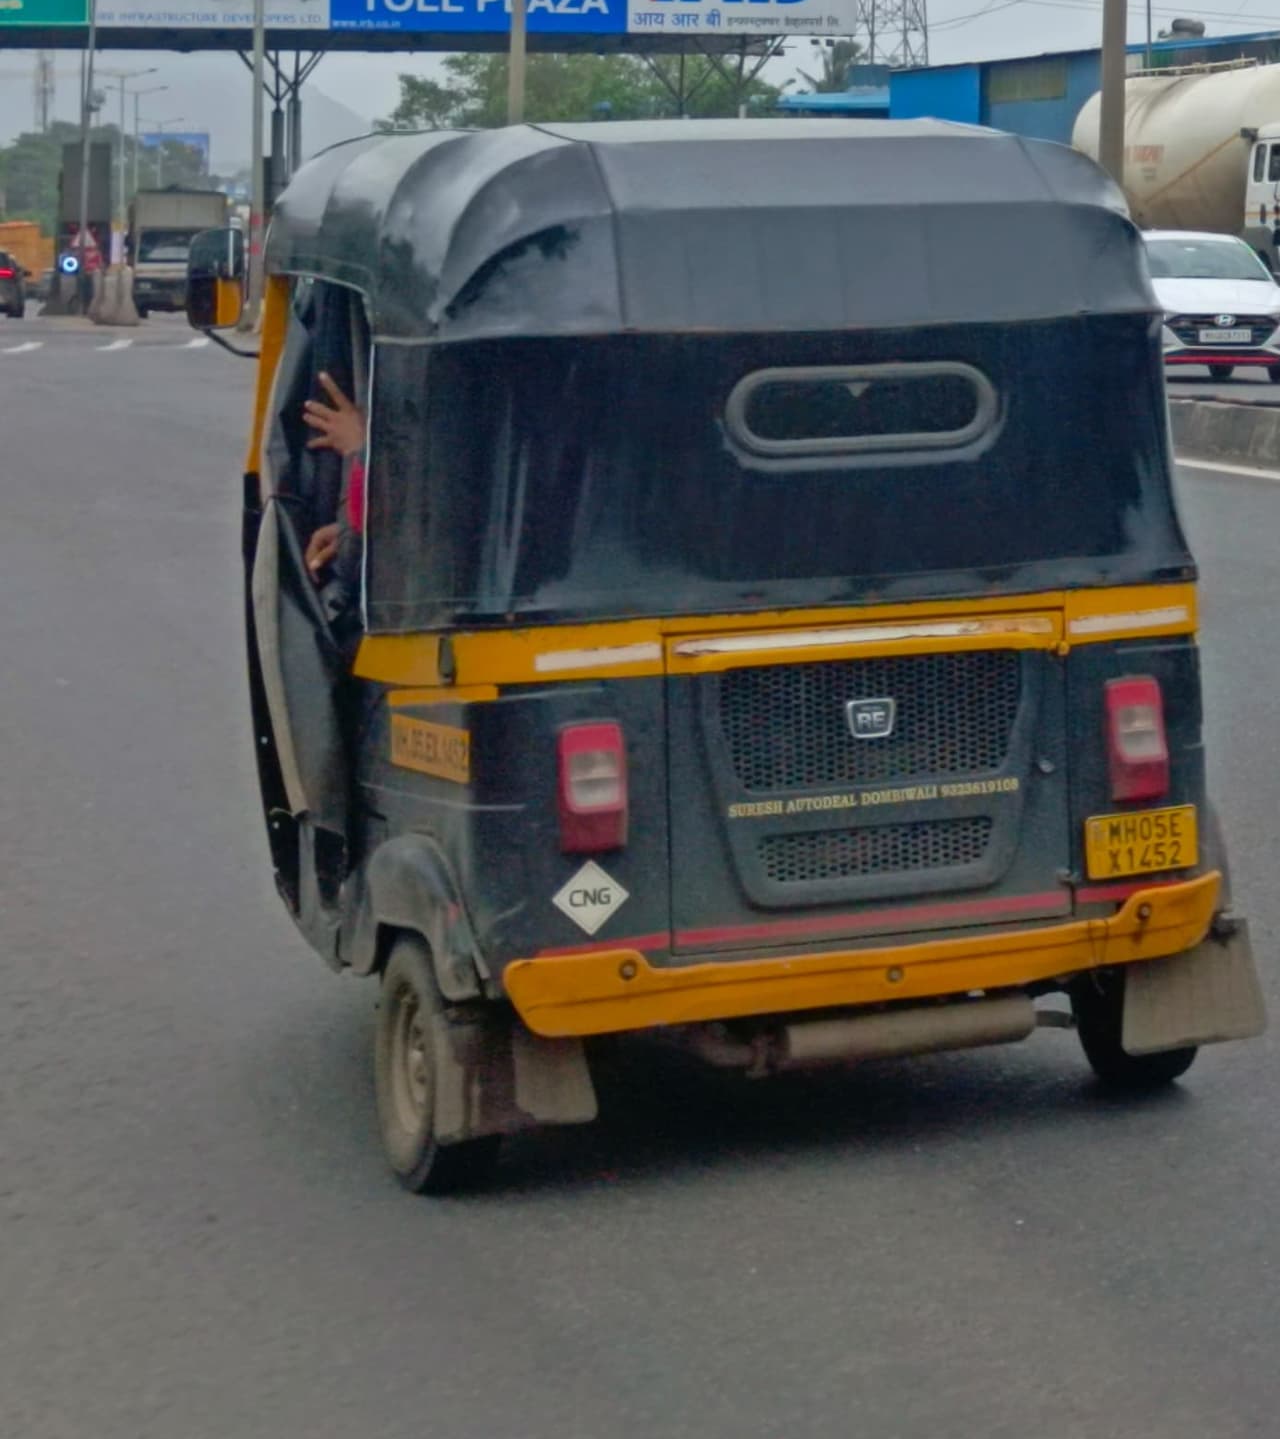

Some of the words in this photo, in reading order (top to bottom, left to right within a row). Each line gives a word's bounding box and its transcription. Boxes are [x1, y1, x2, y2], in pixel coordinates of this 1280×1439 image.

[222, 13, 297, 25] DEVEOPERS
[633, 12, 665, 28] आय
[671, 12, 700, 28] आर
[857, 711, 886, 730] RE
[729, 800, 783, 818] SURESH
[786, 793, 857, 814] AUTODEAL
[861, 785, 938, 806] DOMBIWALI
[1109, 812, 1182, 843] MH05E
[1108, 840, 1182, 872] X1452
[569, 887, 611, 907] CNG
